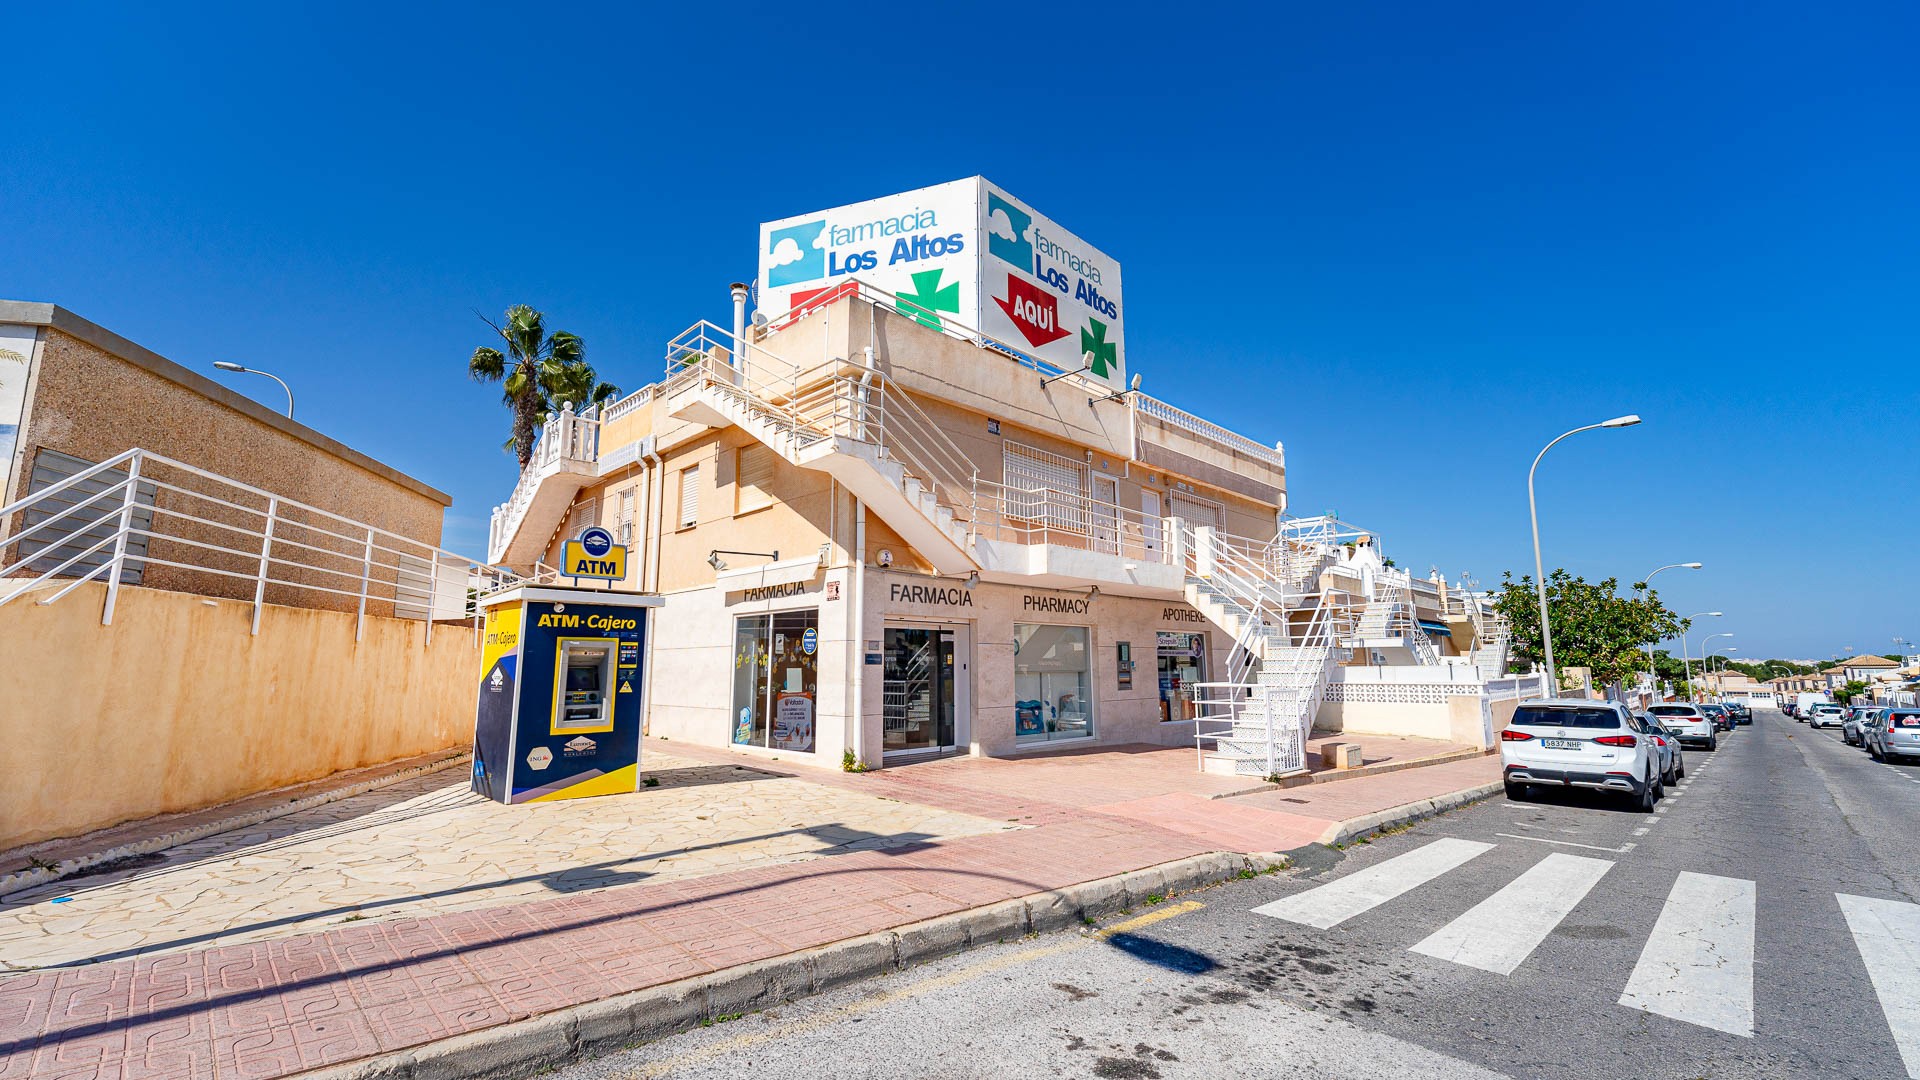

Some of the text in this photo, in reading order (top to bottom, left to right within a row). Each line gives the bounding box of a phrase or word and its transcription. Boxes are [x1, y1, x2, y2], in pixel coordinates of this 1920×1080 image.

[828, 207, 938, 247] farmacia
[829, 233, 964, 277] Los Altos
[1034, 228, 1102, 287] farmacia
[1036, 253, 1117, 320] Los Altos
[1013, 294, 1054, 333] AQUÍ
[576, 560, 616, 575] ATM
[744, 581, 805, 601] FARMACIA
[890, 583, 973, 607] FARMACIA
[1023, 595, 1090, 615] PHARMACY
[1163, 607, 1206, 623] APOTHEKE
